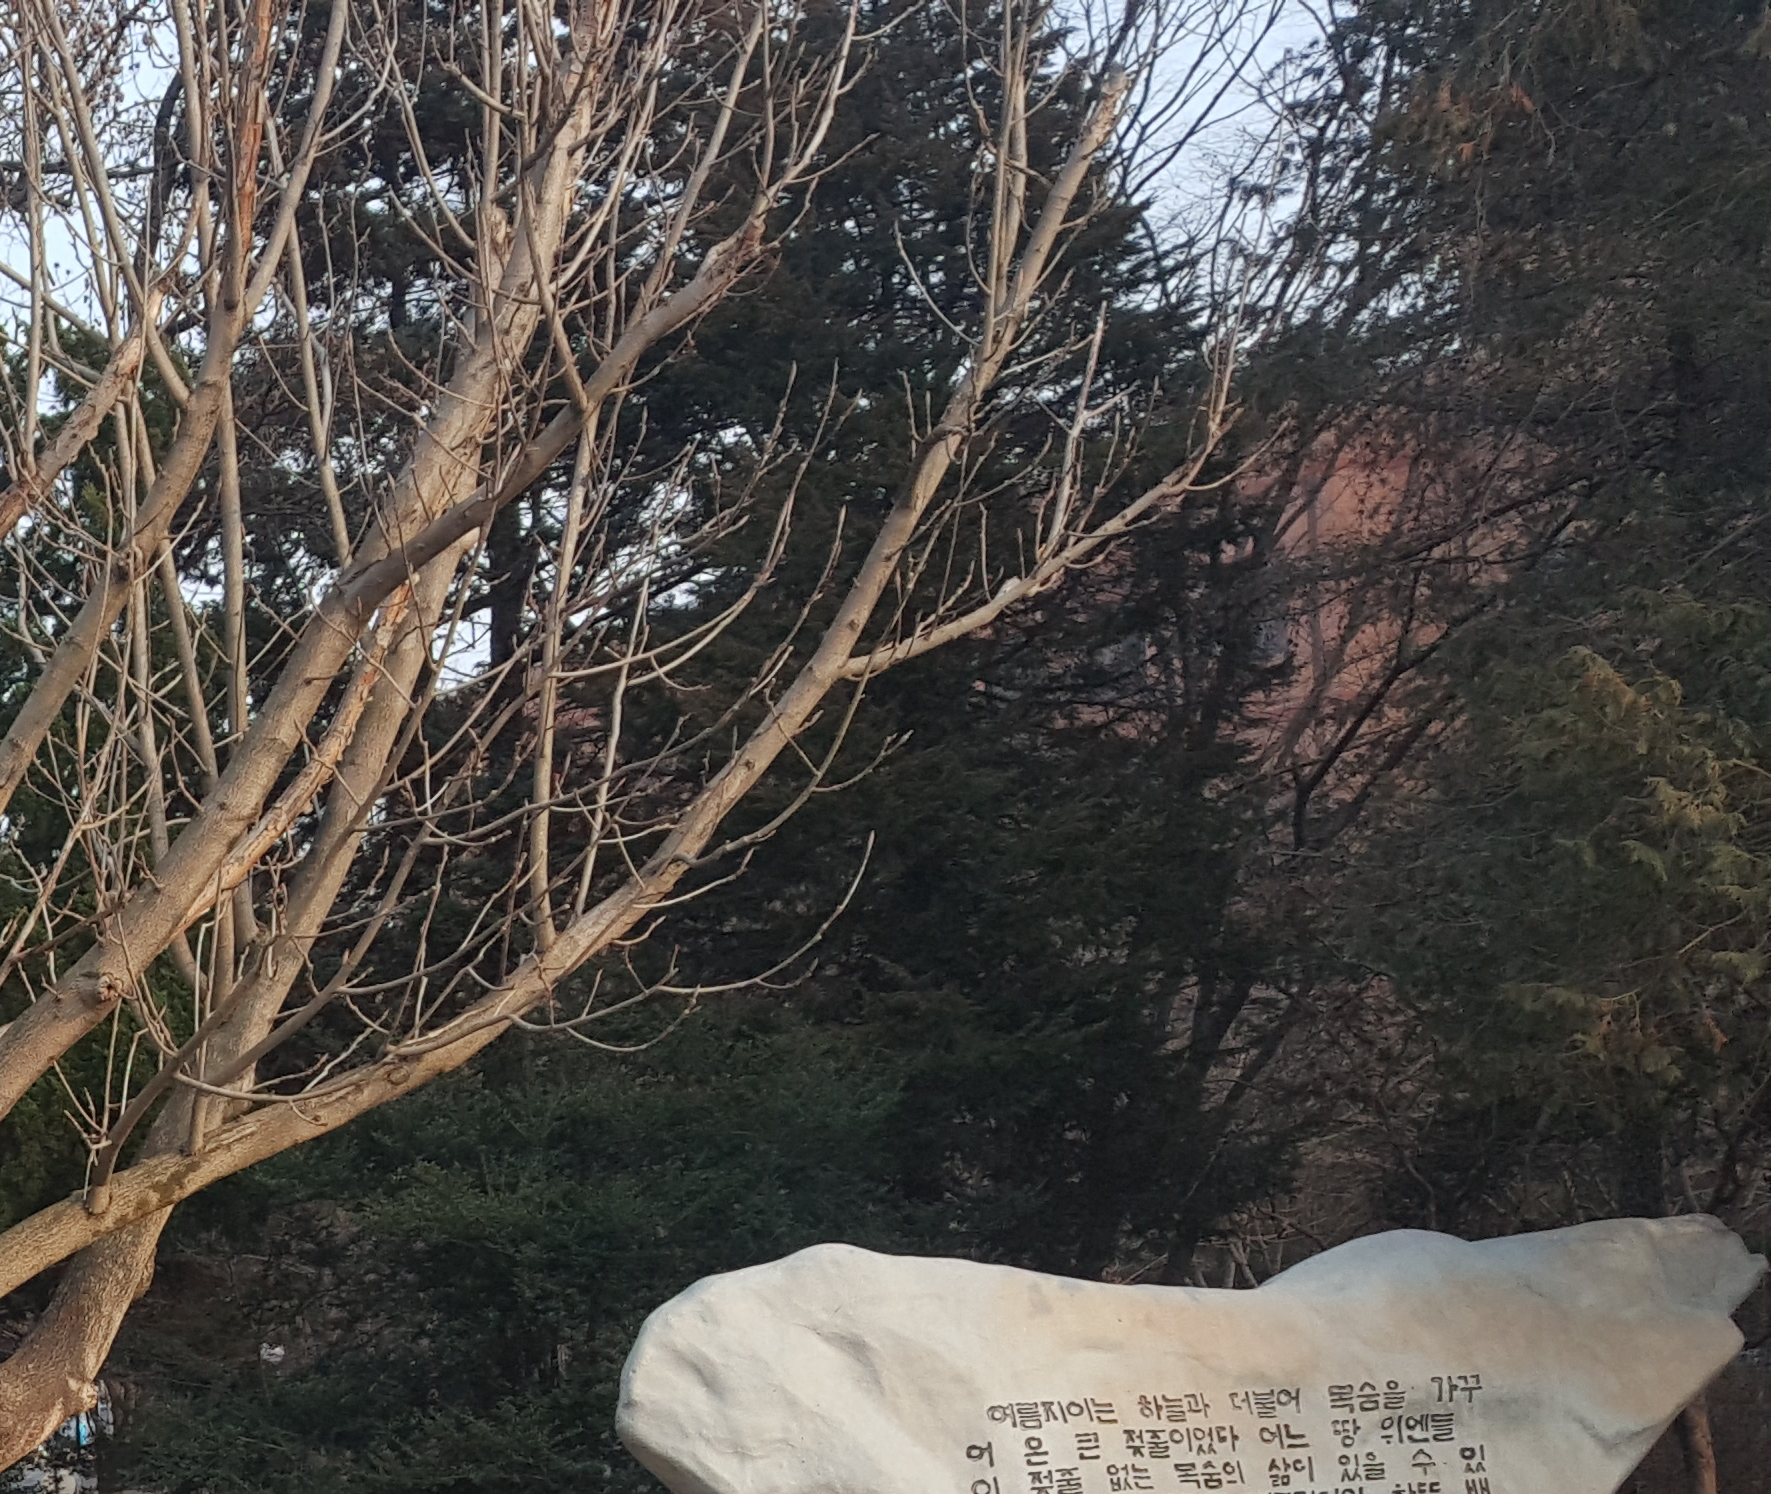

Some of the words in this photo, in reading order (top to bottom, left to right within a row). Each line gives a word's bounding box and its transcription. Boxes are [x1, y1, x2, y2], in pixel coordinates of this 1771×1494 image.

[986, 1397, 1118, 1431] 여름지이는
[1138, 1392, 1210, 1423] 하늘과
[1228, 1387, 1301, 1419] 더불어
[1327, 1379, 1406, 1413] 목숨을
[1430, 1374, 1483, 1403] 가꾸
[966, 1440, 995, 1467] 어
[1023, 1436, 1049, 1467] 온
[1122, 1425, 1240, 1458] 젖줄이었다
[1259, 1423, 1310, 1449] 어느
[1331, 1419, 1361, 1448] 땅
[1380, 1413, 1455, 1444] 위엔들
[1106, 1463, 1154, 1492] 없는
[1173, 1460, 1245, 1489] 목숨의
[1268, 1456, 1314, 1487] 삶이
[1338, 1451, 1386, 1482] 있을
[1411, 1448, 1436, 1475] 수
[1459, 1445, 1486, 1474] 있
